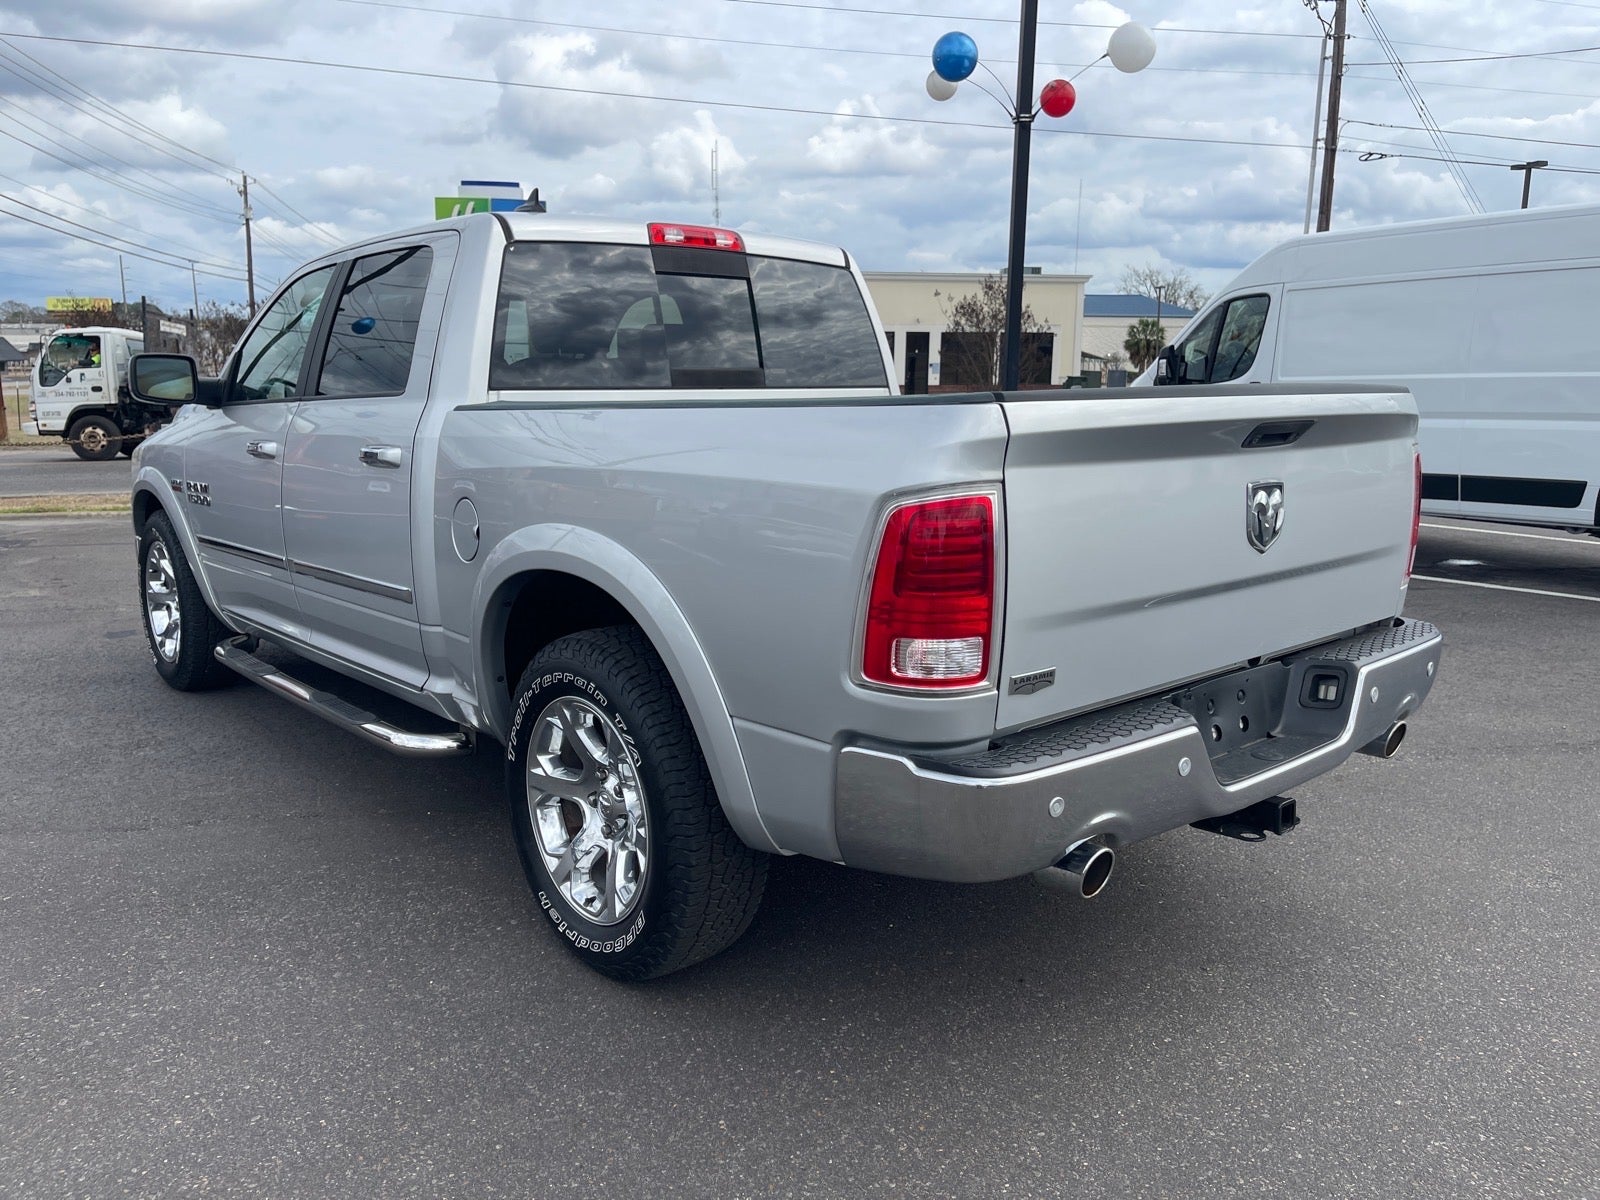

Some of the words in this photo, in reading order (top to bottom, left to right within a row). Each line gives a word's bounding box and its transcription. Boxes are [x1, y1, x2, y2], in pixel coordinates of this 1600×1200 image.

[186, 480, 210, 494] RAM
[187, 492, 212, 507] 1500
[1013, 671, 1055, 686] LARAMIE
[507, 672, 608, 762] Trail-Terrain
[614, 712, 643, 768] T/A
[538, 891, 646, 954] BFGoodrich
